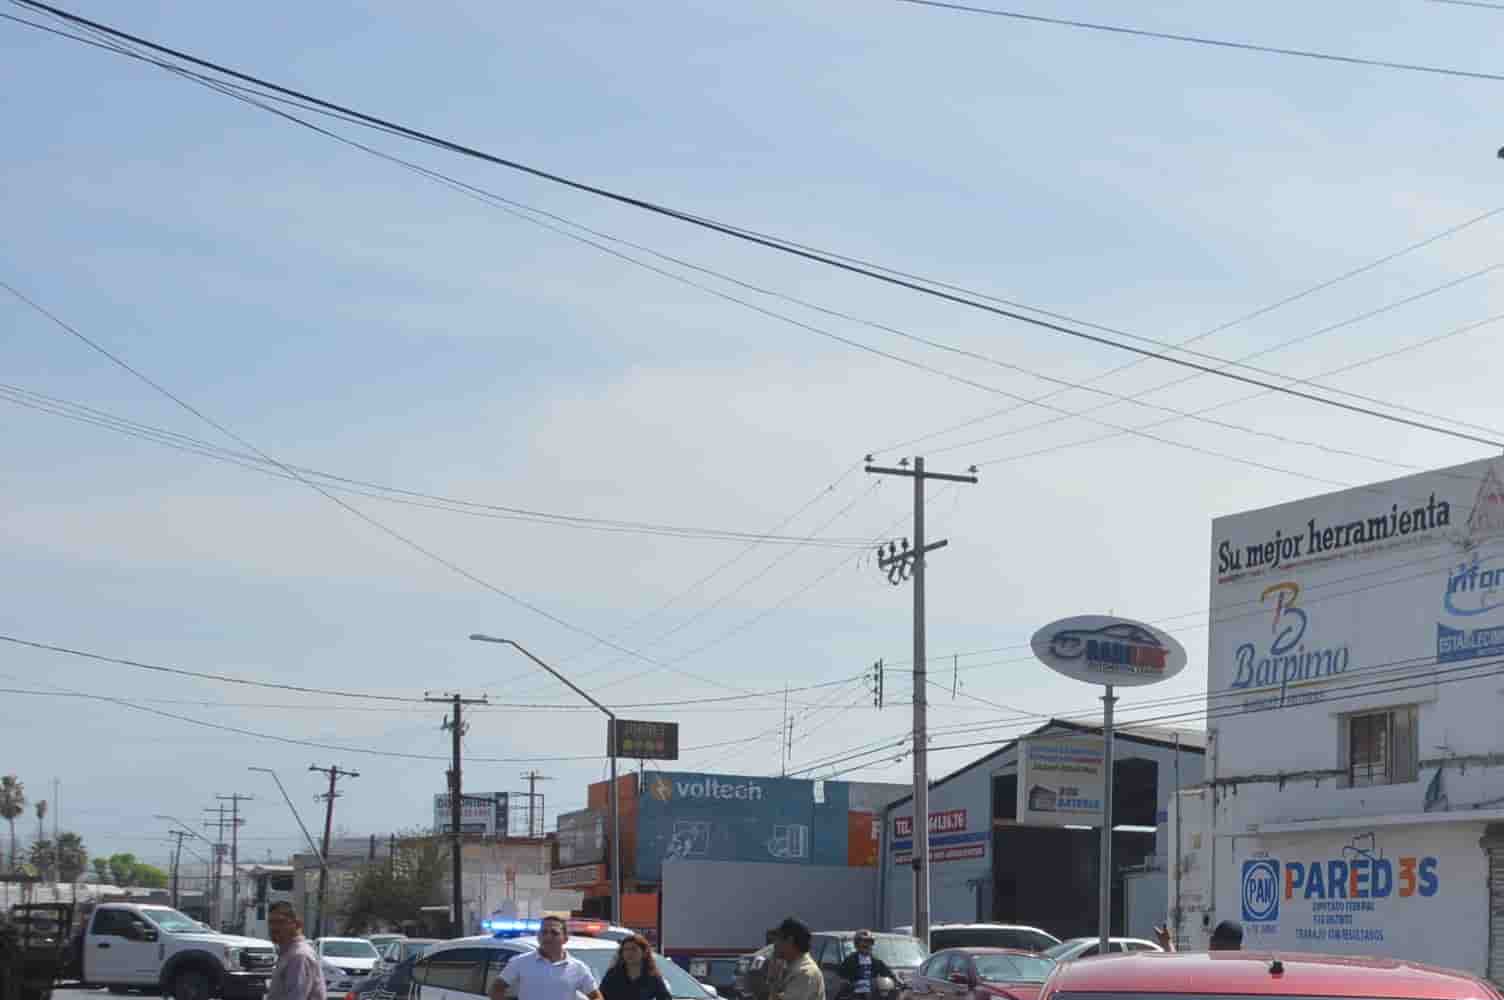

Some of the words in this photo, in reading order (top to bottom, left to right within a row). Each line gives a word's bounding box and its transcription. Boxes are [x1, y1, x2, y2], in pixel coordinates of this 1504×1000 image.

[1217, 540, 1242, 574] Su
[1246, 531, 1305, 568] mejor
[1307, 491, 1451, 555] herramienta
[1230, 643, 1350, 704] Barpimo
[1249, 876, 1273, 905] PAN
